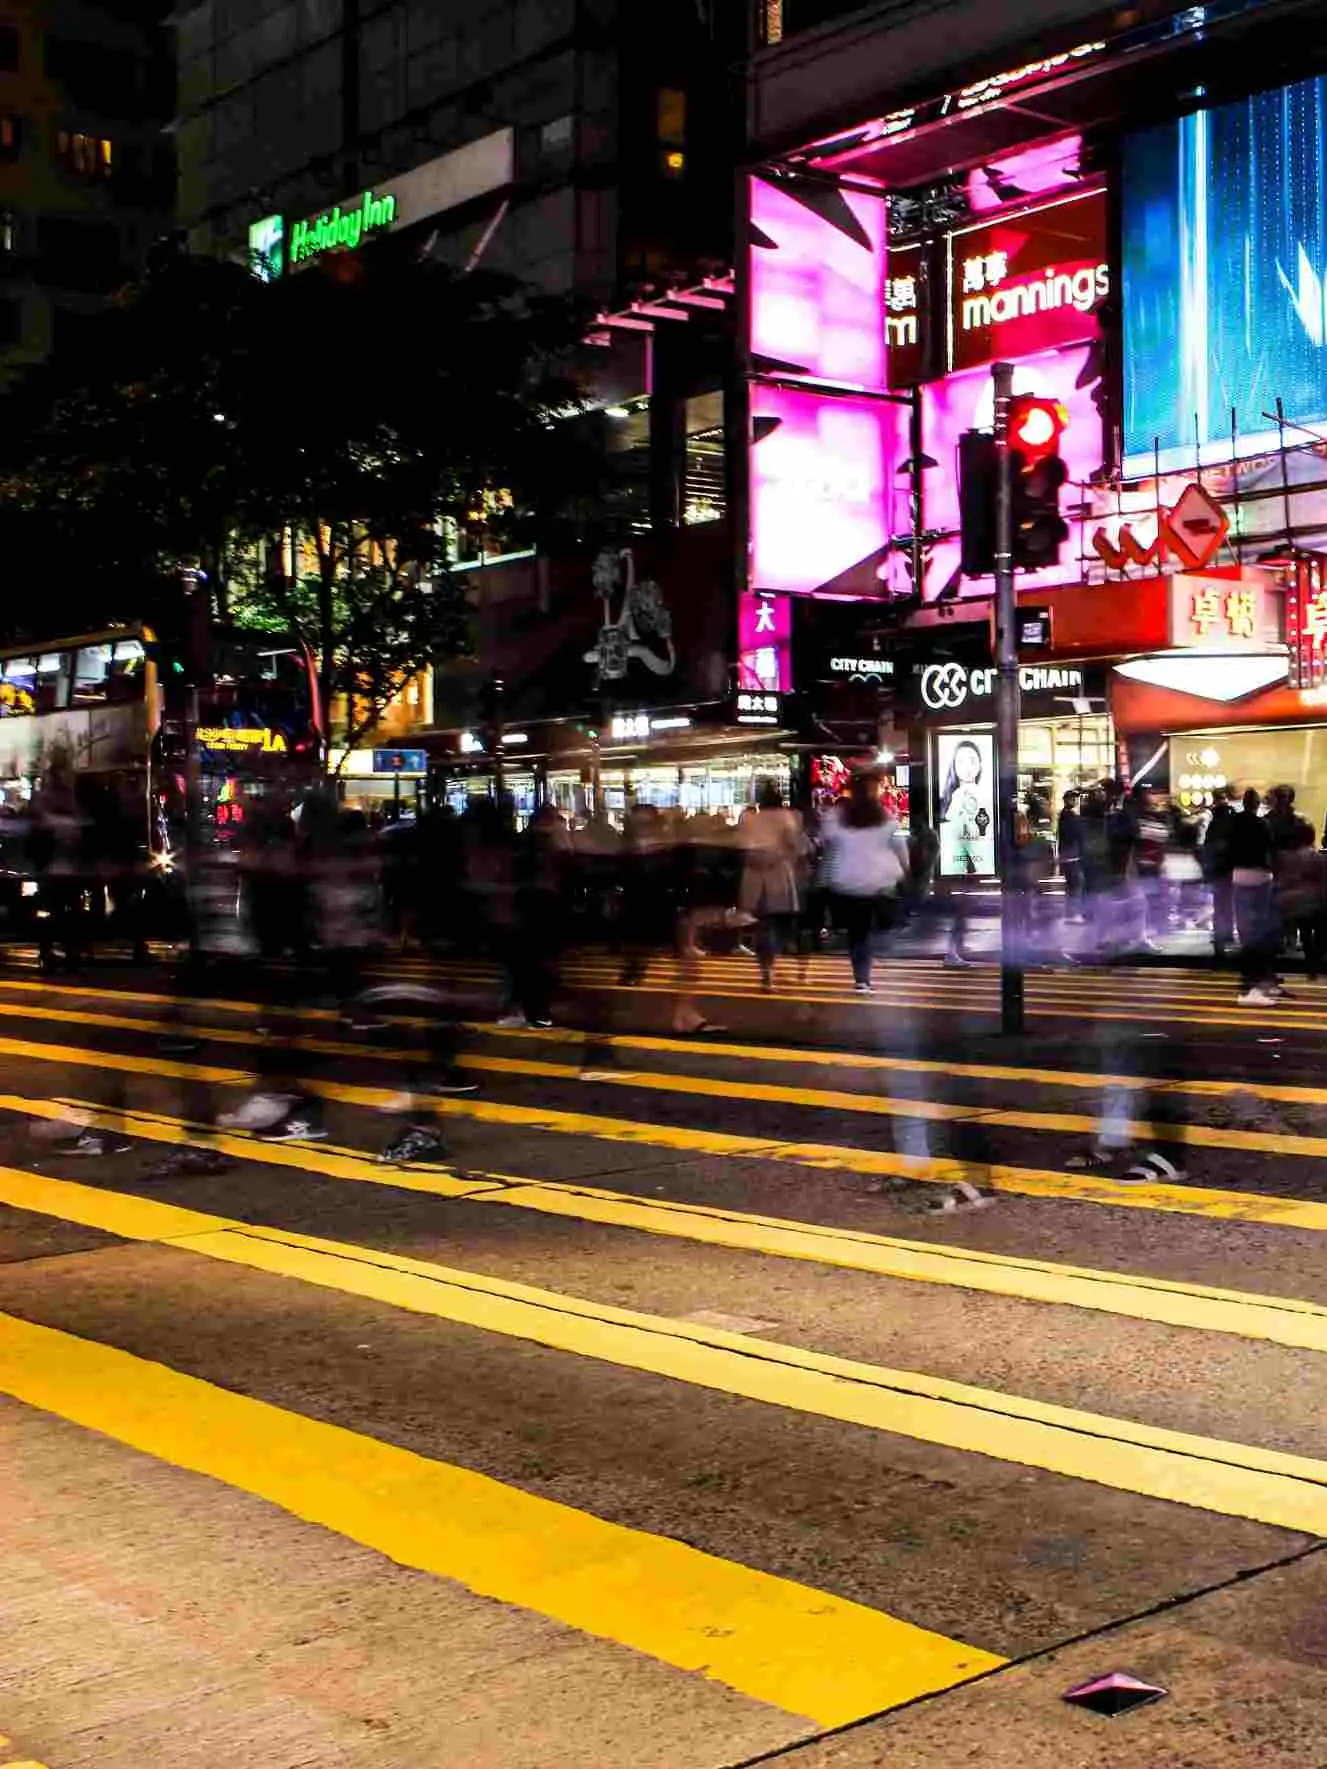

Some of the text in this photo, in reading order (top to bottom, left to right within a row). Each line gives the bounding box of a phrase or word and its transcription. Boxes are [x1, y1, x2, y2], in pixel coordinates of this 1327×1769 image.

[290, 191, 396, 263] Holiday Inn
[962, 263, 1109, 330] mannings
